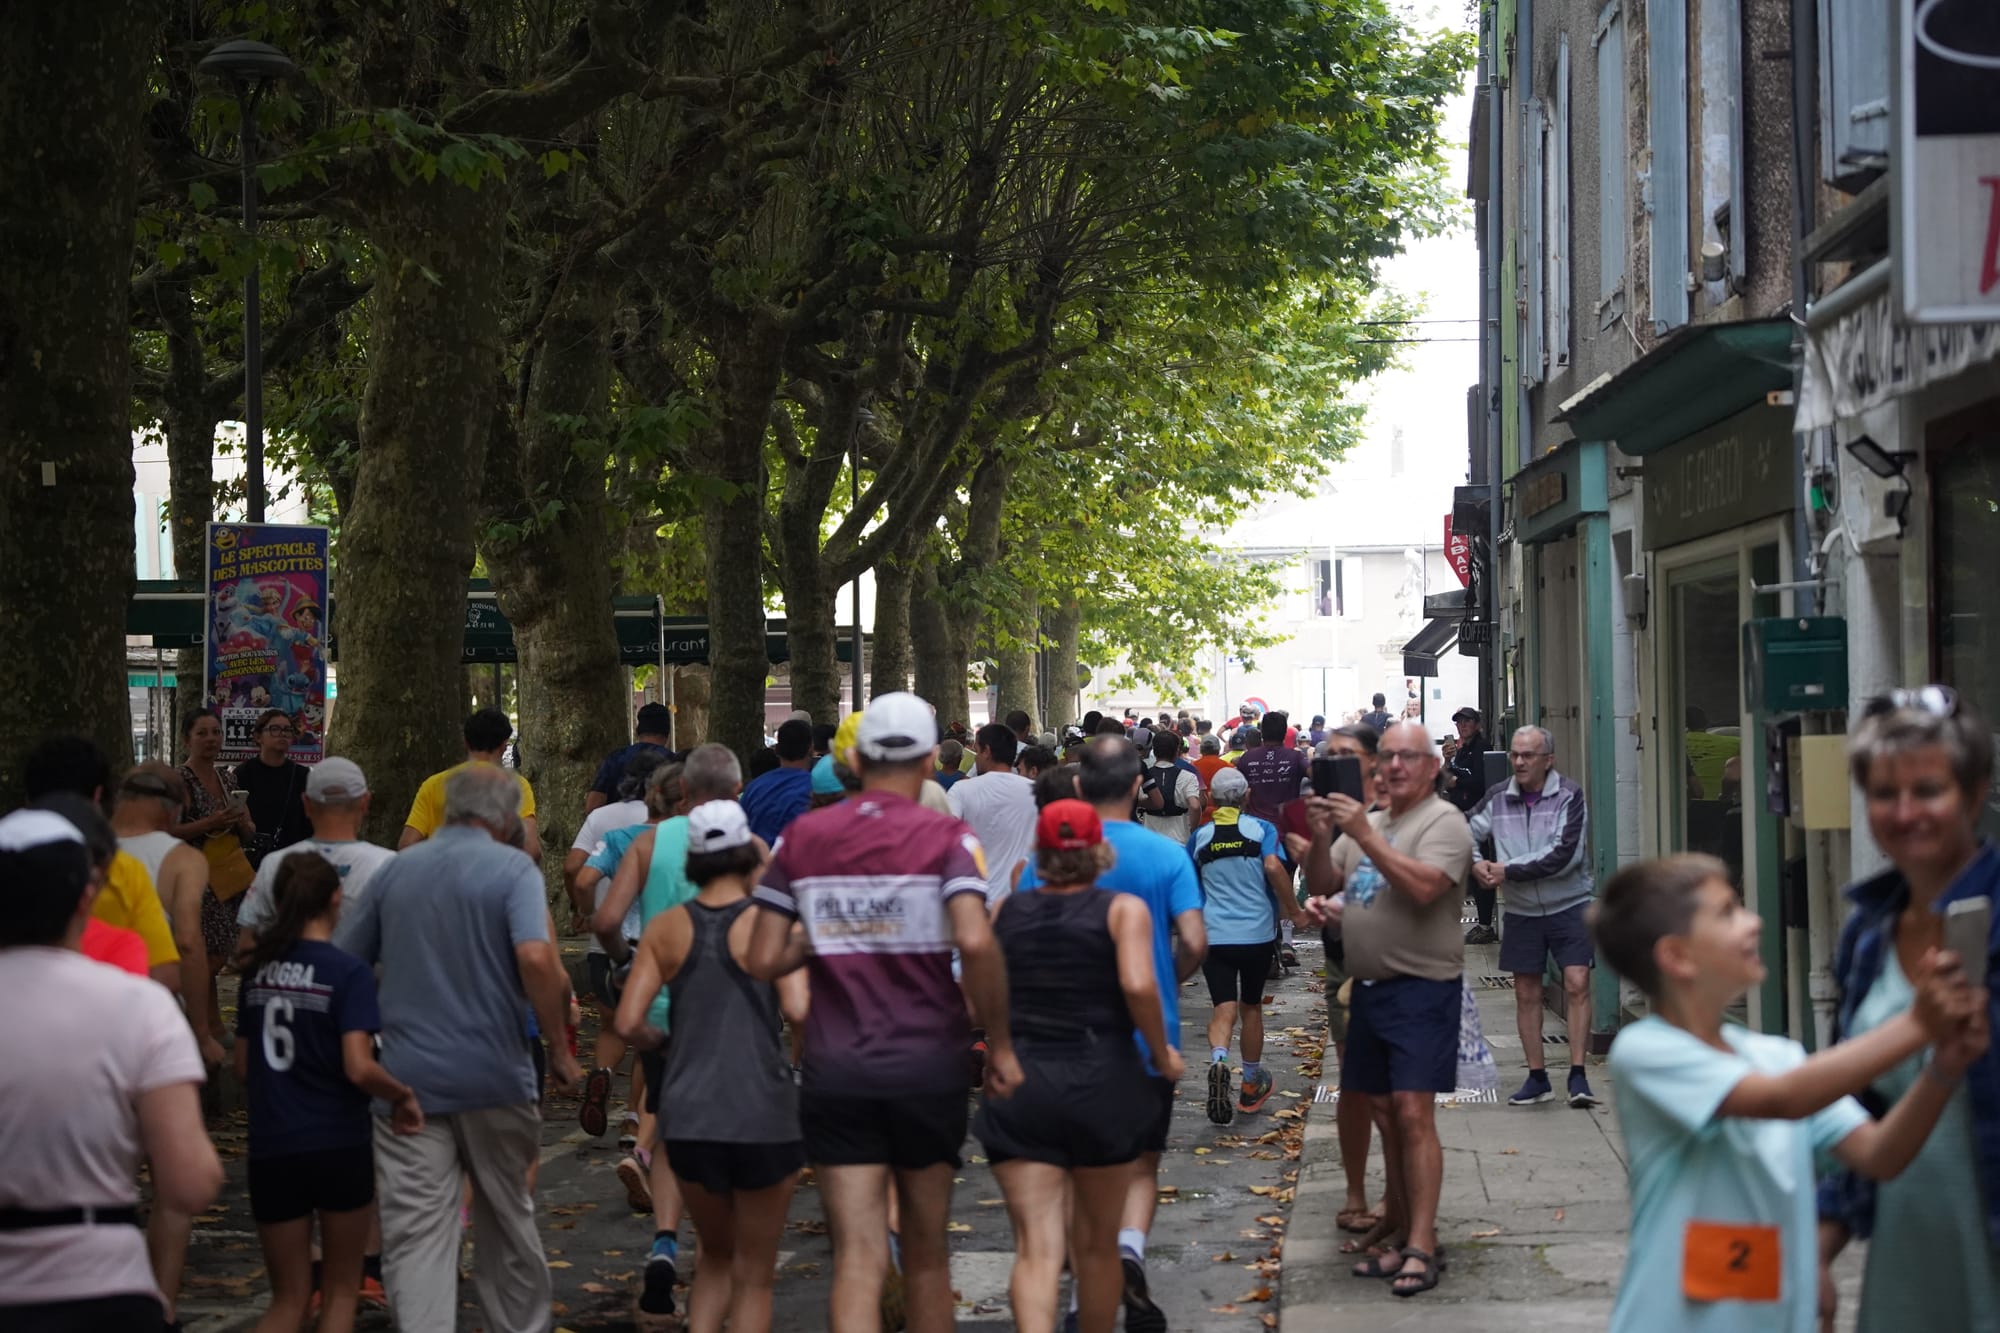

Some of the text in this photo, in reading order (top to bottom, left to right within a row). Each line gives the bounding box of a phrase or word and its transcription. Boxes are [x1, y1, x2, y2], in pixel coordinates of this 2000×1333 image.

[220, 542, 316, 565] LE SPECTACLE
[1448, 527, 1469, 574] ABAC
[213, 557, 324, 582] DES MASCOTTES
[1460, 622, 1491, 642] COIFFEU
[216, 649, 279, 662] PHOTOS SOUVENIRS
[228, 656, 266, 668] AVEC LES
[220, 664, 276, 678] PERSONNAGES
[262, 996, 295, 1072] 6
[1727, 1238, 1752, 1273] 2
